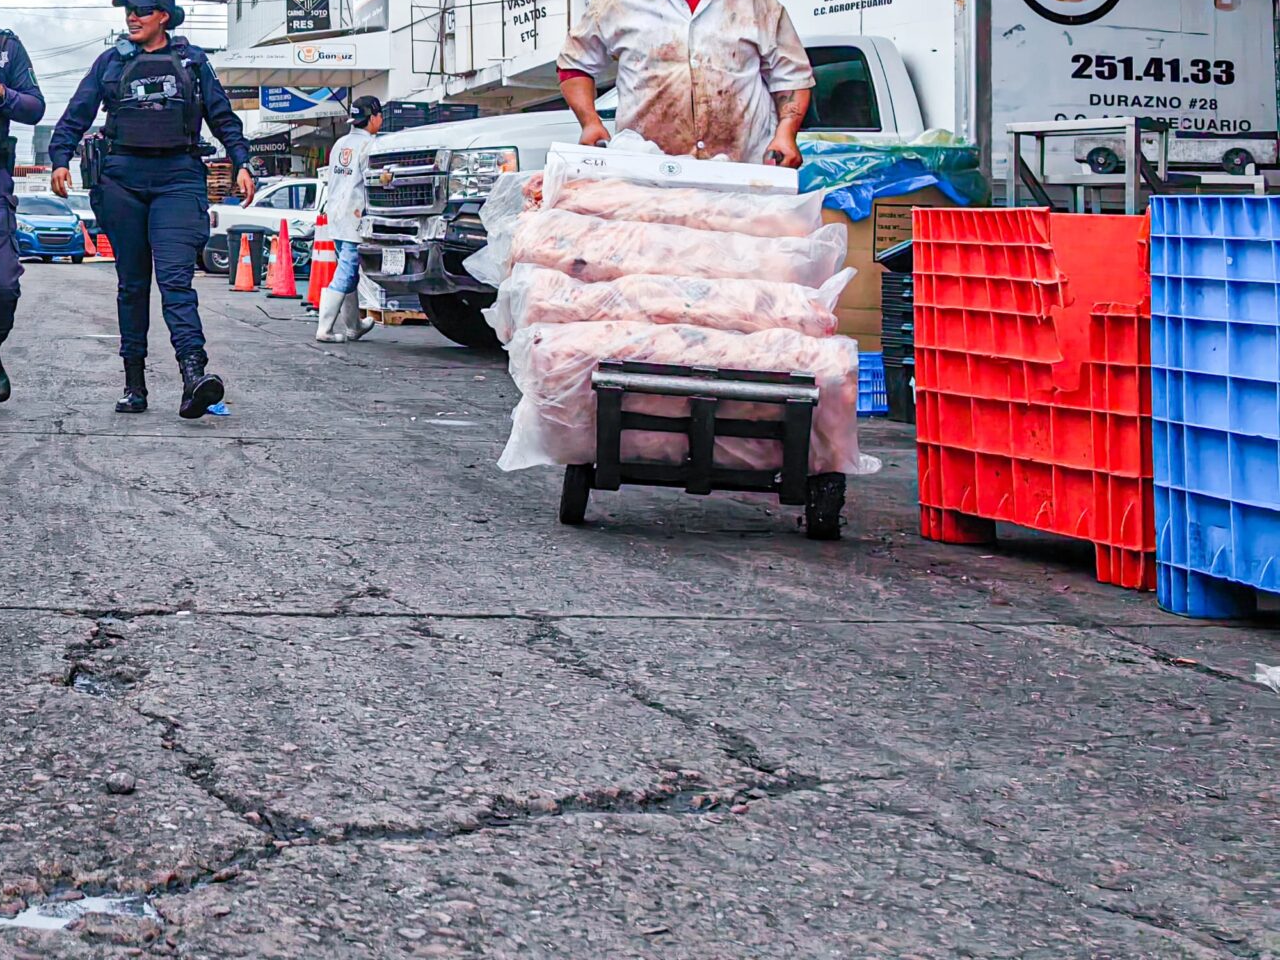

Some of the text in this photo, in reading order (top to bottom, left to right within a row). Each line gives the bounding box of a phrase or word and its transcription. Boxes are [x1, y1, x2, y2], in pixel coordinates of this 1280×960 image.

[513, 7, 547, 26] PLATOS
[813, 7, 828, 16] C.C.
[293, 20, 314, 29] RES
[520, 31, 539, 43] ETC.
[1071, 54, 1236, 86] 251.41.33
[1089, 93, 1218, 111] DURAZNO #28
[249, 143, 286, 152] NVENIDOS
